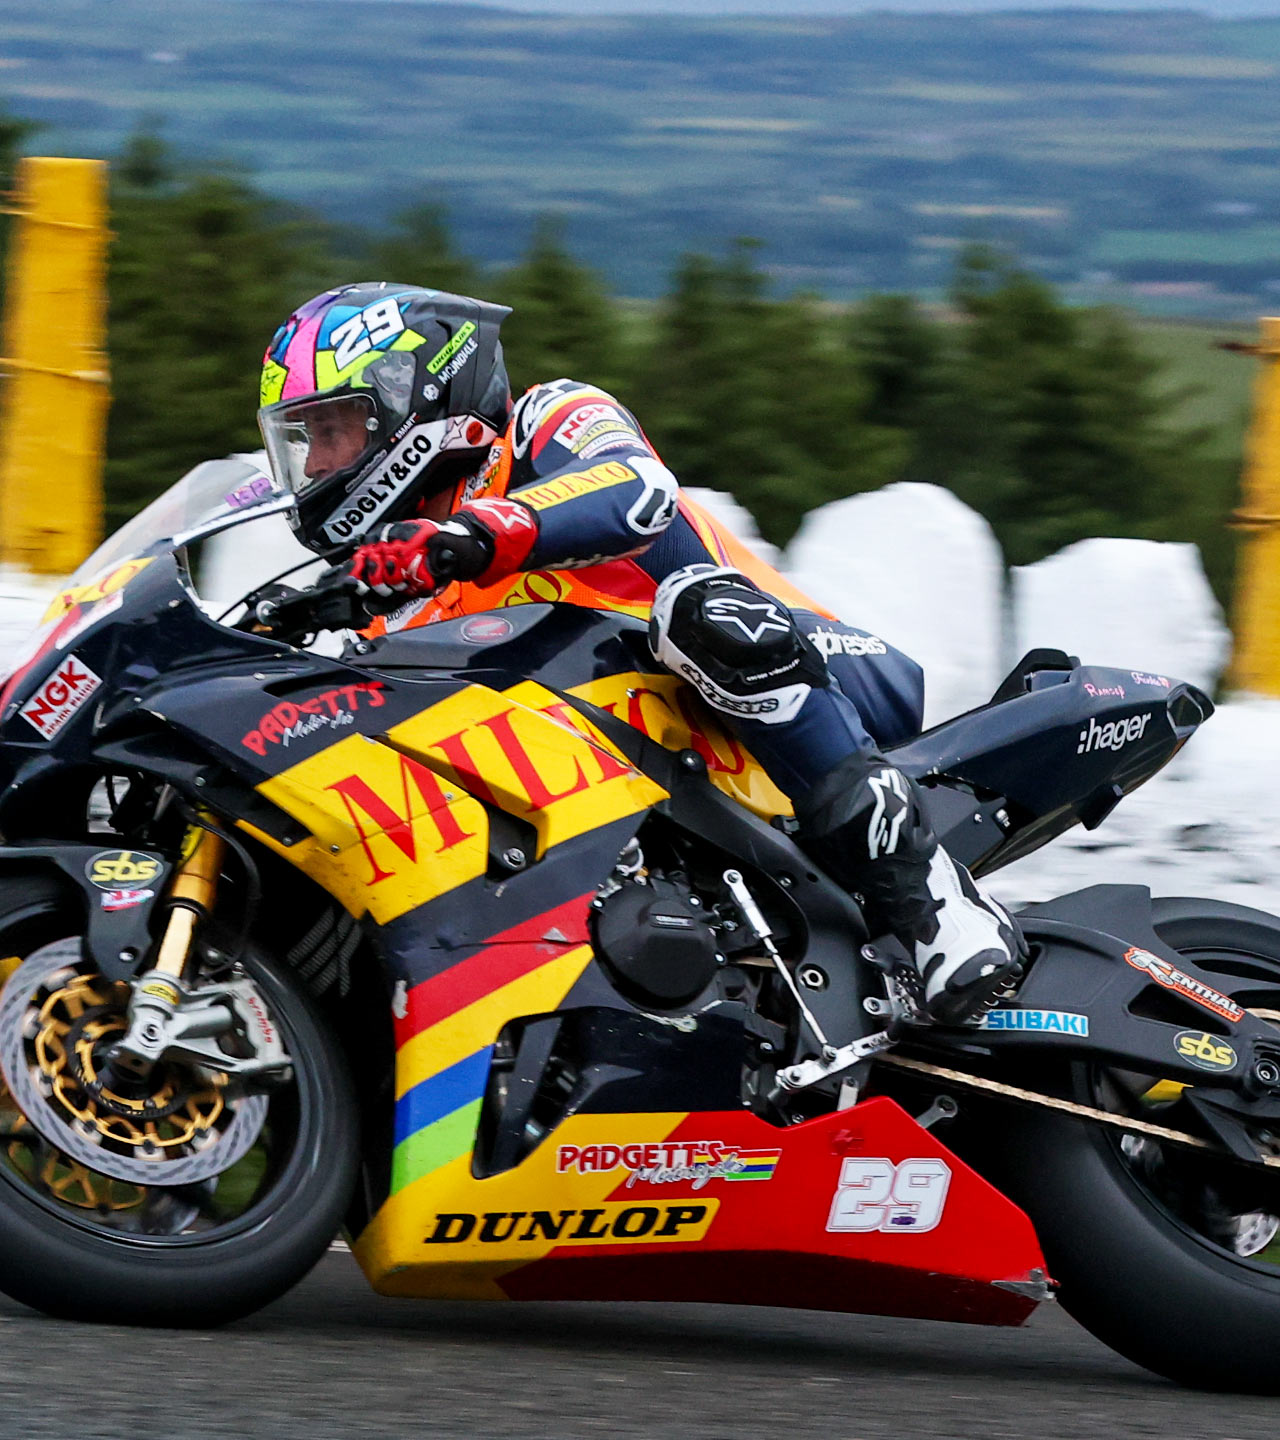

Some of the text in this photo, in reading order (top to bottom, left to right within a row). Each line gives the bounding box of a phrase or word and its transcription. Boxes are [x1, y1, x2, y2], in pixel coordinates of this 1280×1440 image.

[330, 298, 405, 372] 29
[24, 660, 89, 728] NGK
[91, 851, 158, 882] sbs
[987, 1010, 1087, 1036] SUBAKI
[1178, 1033, 1233, 1066] sbs
[557, 1141, 726, 1175] PADGETT'S
[825, 1157, 952, 1233] 29
[423, 1205, 708, 1244] DUNLOP
